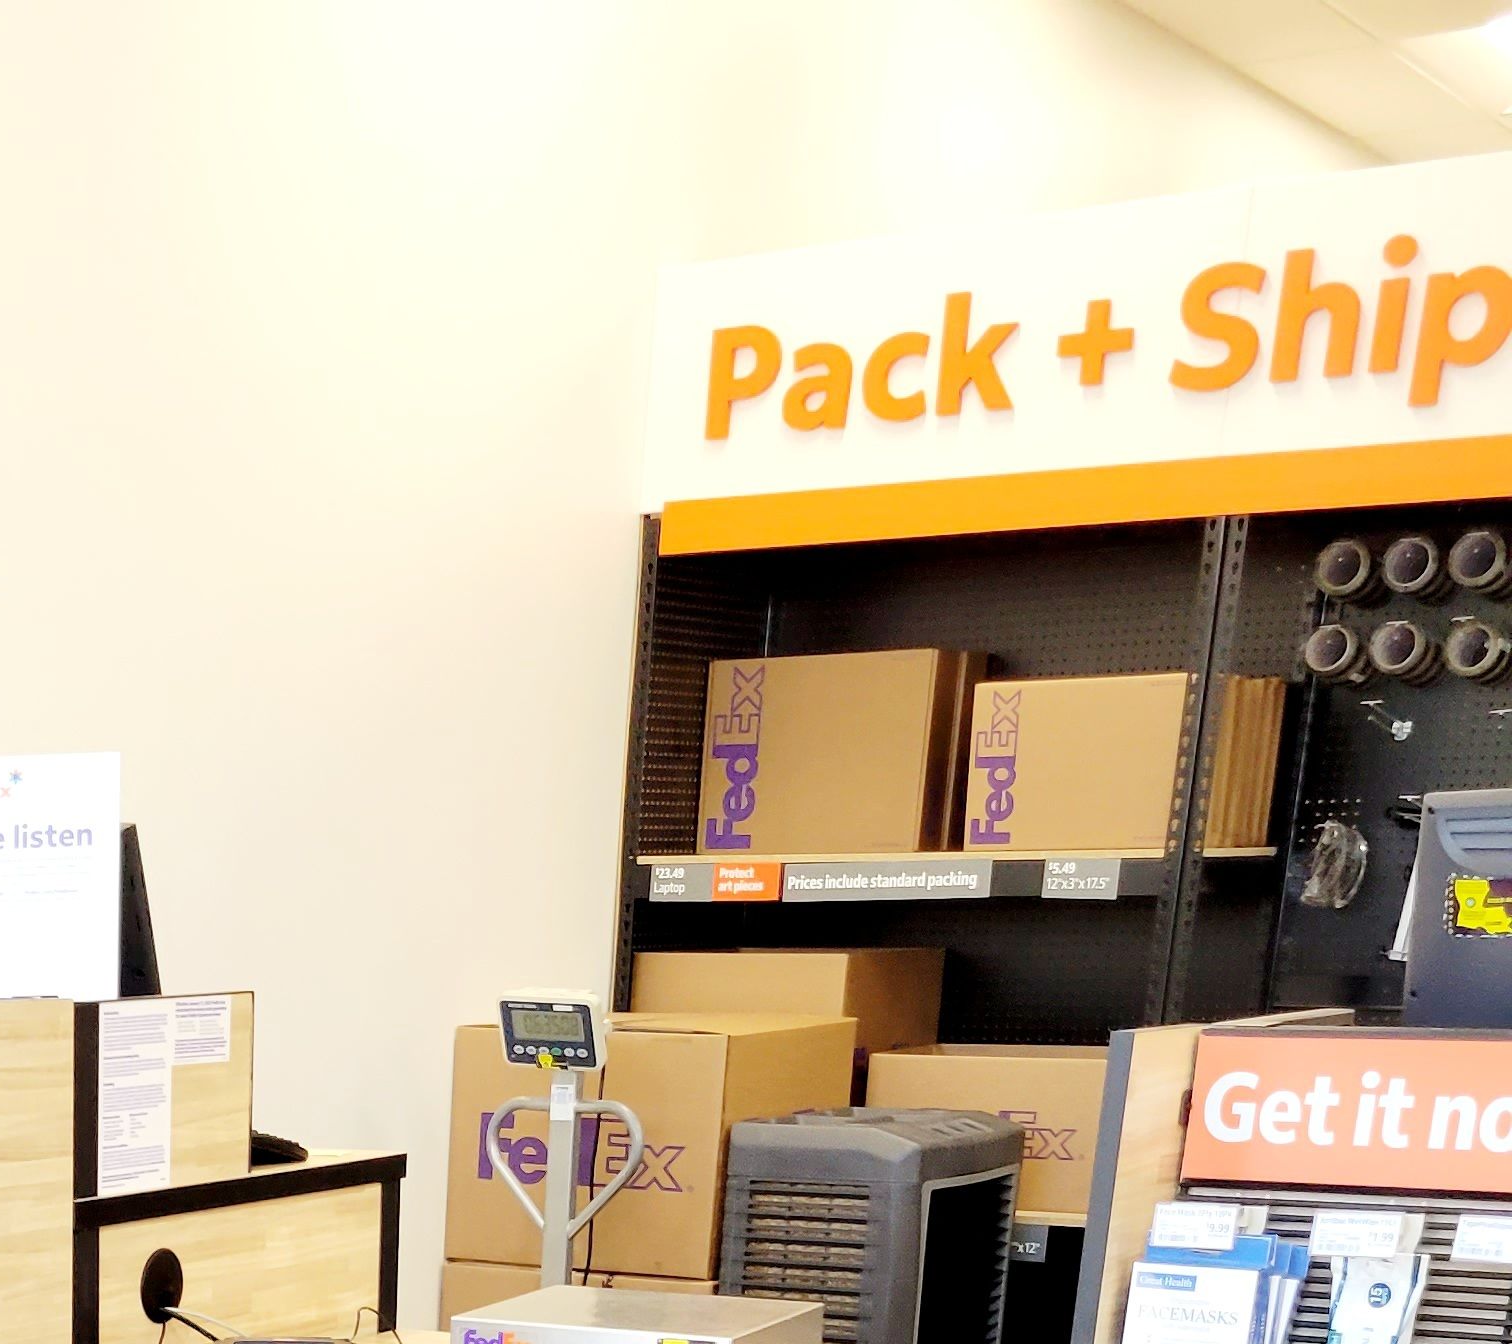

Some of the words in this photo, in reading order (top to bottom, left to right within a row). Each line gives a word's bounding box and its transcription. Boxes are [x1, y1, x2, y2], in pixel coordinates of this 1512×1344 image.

[704, 290, 1021, 441] Pack
[1057, 298, 1135, 388] +
[1167, 233, 1512, 408] Ship
[705, 664, 766, 850] FedEx
[969, 689, 1022, 845] FedEx
[13, 823, 94, 850] listen
[655, 867, 685, 880] $23.49
[719, 867, 755, 879] Protect
[1048, 862, 1076, 874] $5.49
[653, 881, 686, 895] Laptop
[717, 881, 733, 892] art
[733, 880, 765, 894] pieces
[787, 874, 825, 891] Prices
[824, 873, 870, 890] include
[869, 870, 926, 889] standard
[926, 870, 978, 890] packing
[1203, 1070, 1340, 1144] Get
[1353, 1070, 1415, 1148] it
[1427, 1093, 1512, 1150] no
[1164, 1277, 1193, 1289] Health
[1138, 1304, 1239, 1326] FACEMASKS
